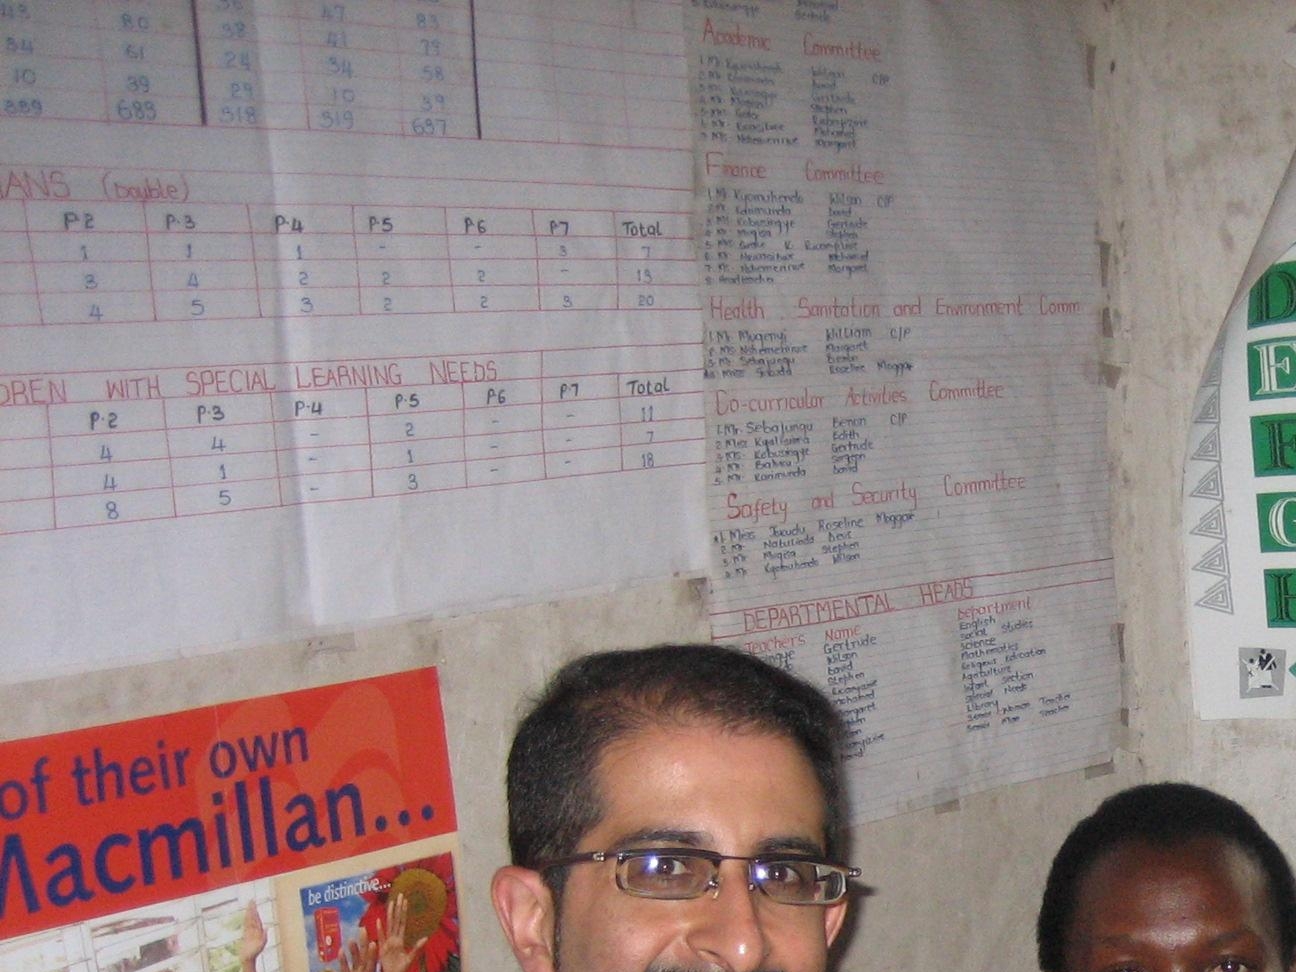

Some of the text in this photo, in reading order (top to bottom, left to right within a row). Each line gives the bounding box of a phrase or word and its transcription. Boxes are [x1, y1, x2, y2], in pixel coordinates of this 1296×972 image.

[622, 220, 663, 238] Total
[709, 294, 1082, 321] Health Sanitation and Environment Comm
[106, 374, 161, 400] WITH
[186, 368, 276, 396] SPECIAL
[296, 361, 402, 389] LEARNING
[430, 359, 498, 384] NEEDS
[626, 379, 671, 396] Total
[715, 385, 825, 415] Co-curricular
[929, 379, 1005, 403] Committee
[726, 473, 1027, 522] Safety and Security Committee
[743, 578, 974, 633] DEPARTMENTAL HEADS
[743, 633, 807, 657] Teachers
[825, 624, 861, 641] Name
[0, 725, 309, 822] of their own
[307, 875, 392, 906] be distinctive...
